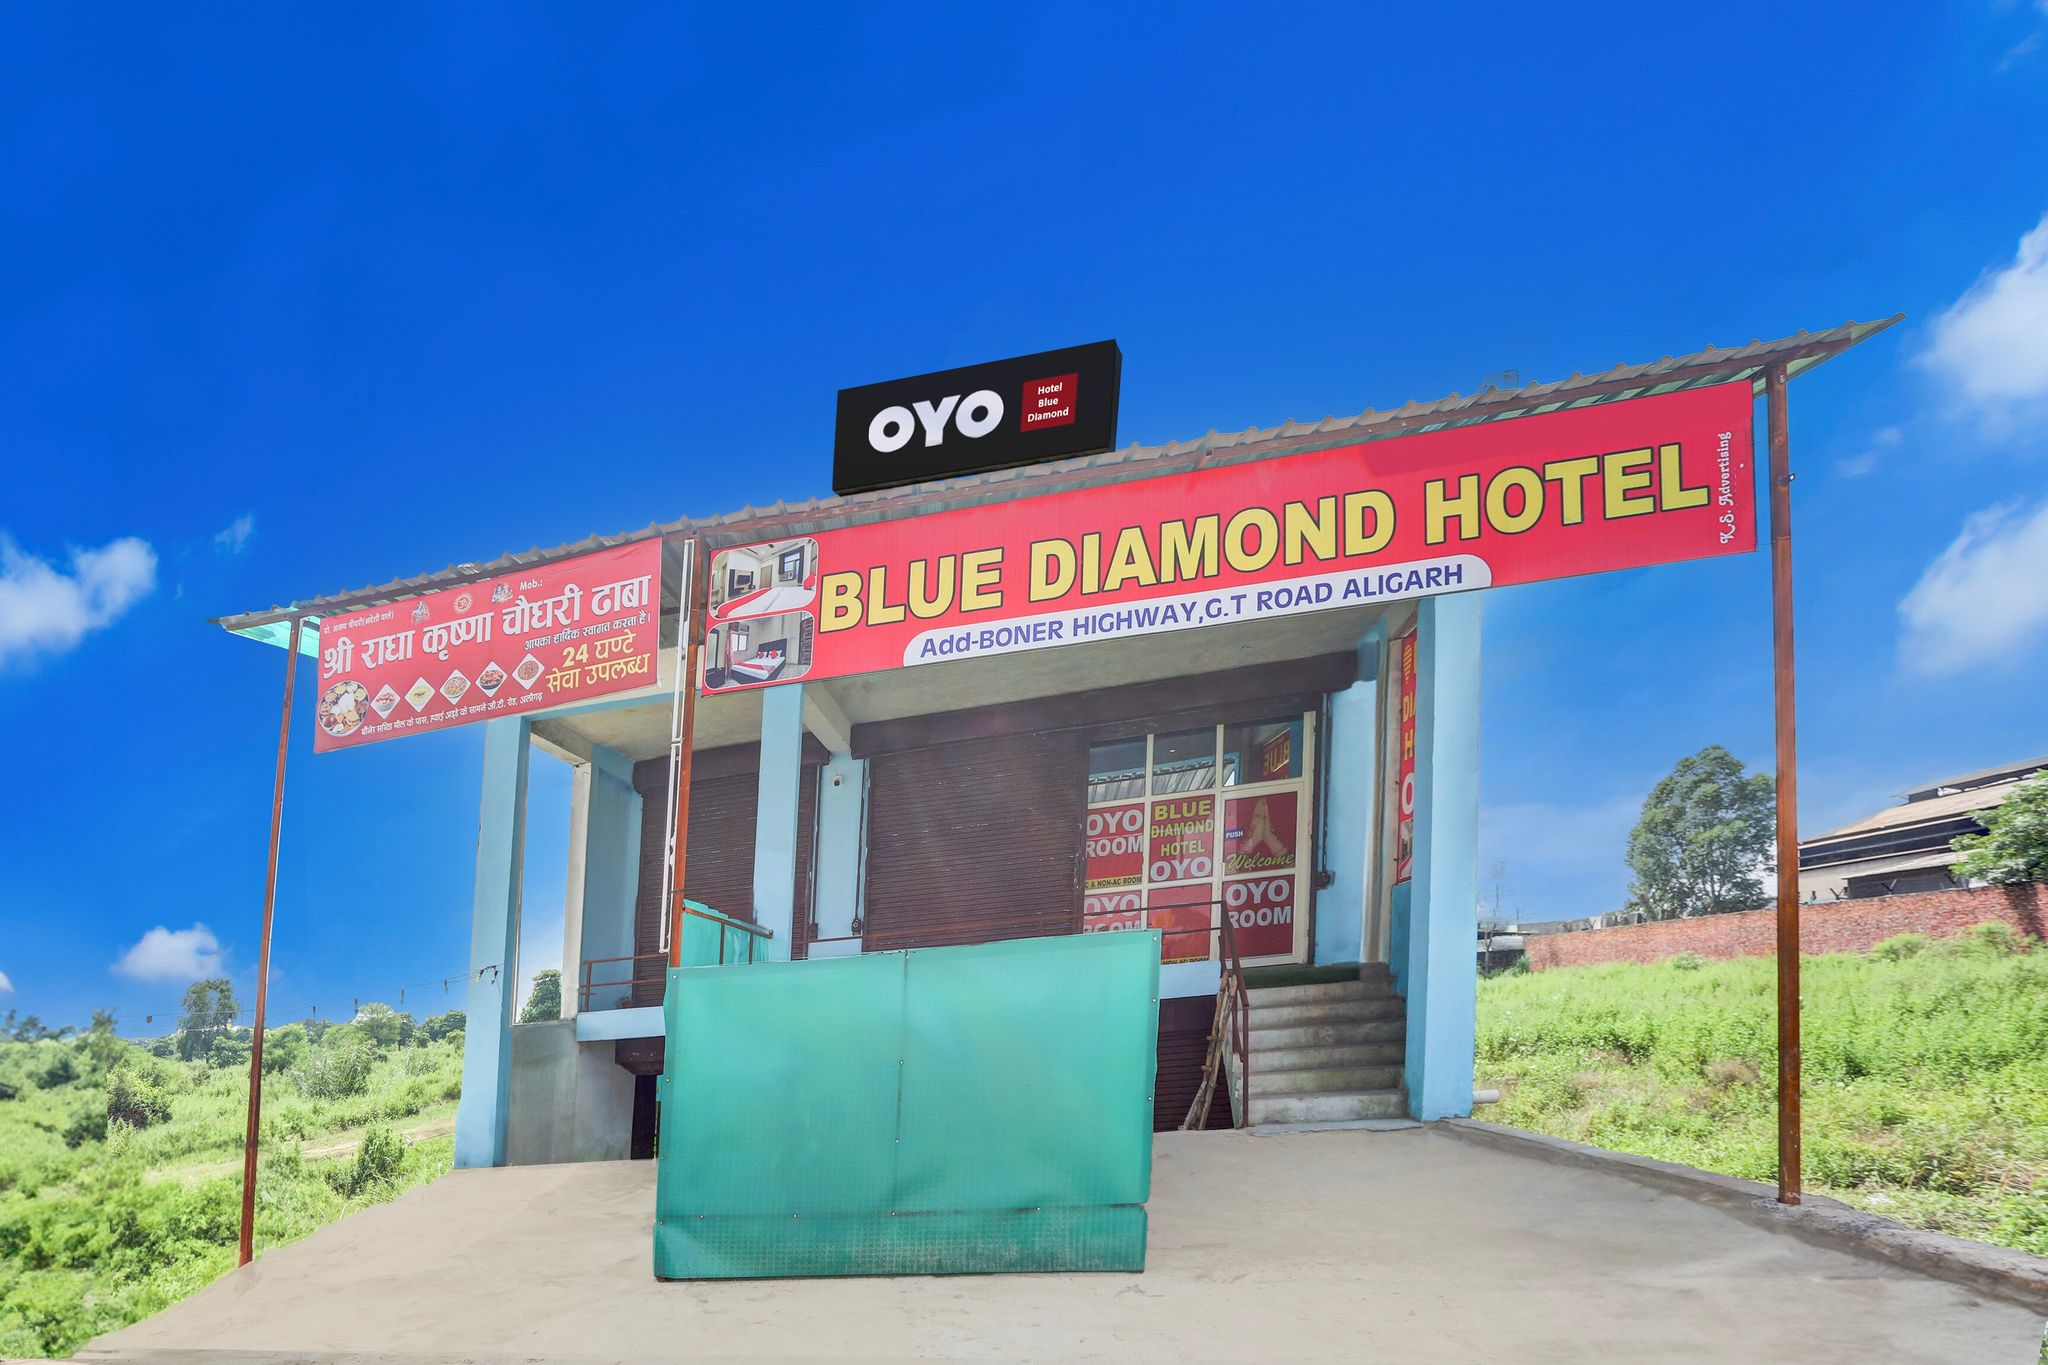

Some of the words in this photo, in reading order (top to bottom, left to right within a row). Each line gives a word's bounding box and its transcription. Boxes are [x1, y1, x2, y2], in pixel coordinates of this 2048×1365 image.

[1037, 382, 1063, 395] Hotel
[1038, 396, 1059, 408] Blue
[868, 389, 1005, 453] OYO
[1027, 407, 1069, 423] Diamond
[1717, 431, 1734, 507] Advertising
[819, 547, 1004, 634] BLUE
[1028, 489, 1396, 603] DIAMOND
[1424, 441, 1711, 546] HOTEL
[920, 619, 1064, 658] Add-BONER
[1256, 582, 1333, 613] ROAD
[1343, 563, 1464, 600] ALIGARH
[323, 636, 355, 679] श्री
[361, 630, 416, 669] राधा
[422, 612, 495, 661] कृष्णा
[502, 583, 584, 635] चौधरी
[591, 575, 652, 616] ढाबा
[524, 636, 551, 651] आपका
[553, 627, 580, 644] हार्दिक
[582, 622, 611, 636] स्वागत
[613, 615, 638, 629] करता
[562, 643, 589, 668] 24
[594, 629, 637, 659] घण्टे
[545, 667, 581, 694] सेवा
[585, 653, 651, 685] उपलब्ध
[1086, 809, 1143, 836] OYO
[1155, 800, 1211, 820] BLUE
[1151, 819, 1213, 838] DIAMOND
[1226, 830, 1244, 839] PUSH
[1086, 834, 1144, 858] ROOM
[1161, 840, 1205, 857] HOTEL
[1151, 857, 1212, 881] OYO
[1226, 851, 1295, 871] Welcome
[1226, 879, 1290, 906] OYO
[1084, 894, 1140, 920] OYO
[1228, 905, 1291, 928] ROOM
